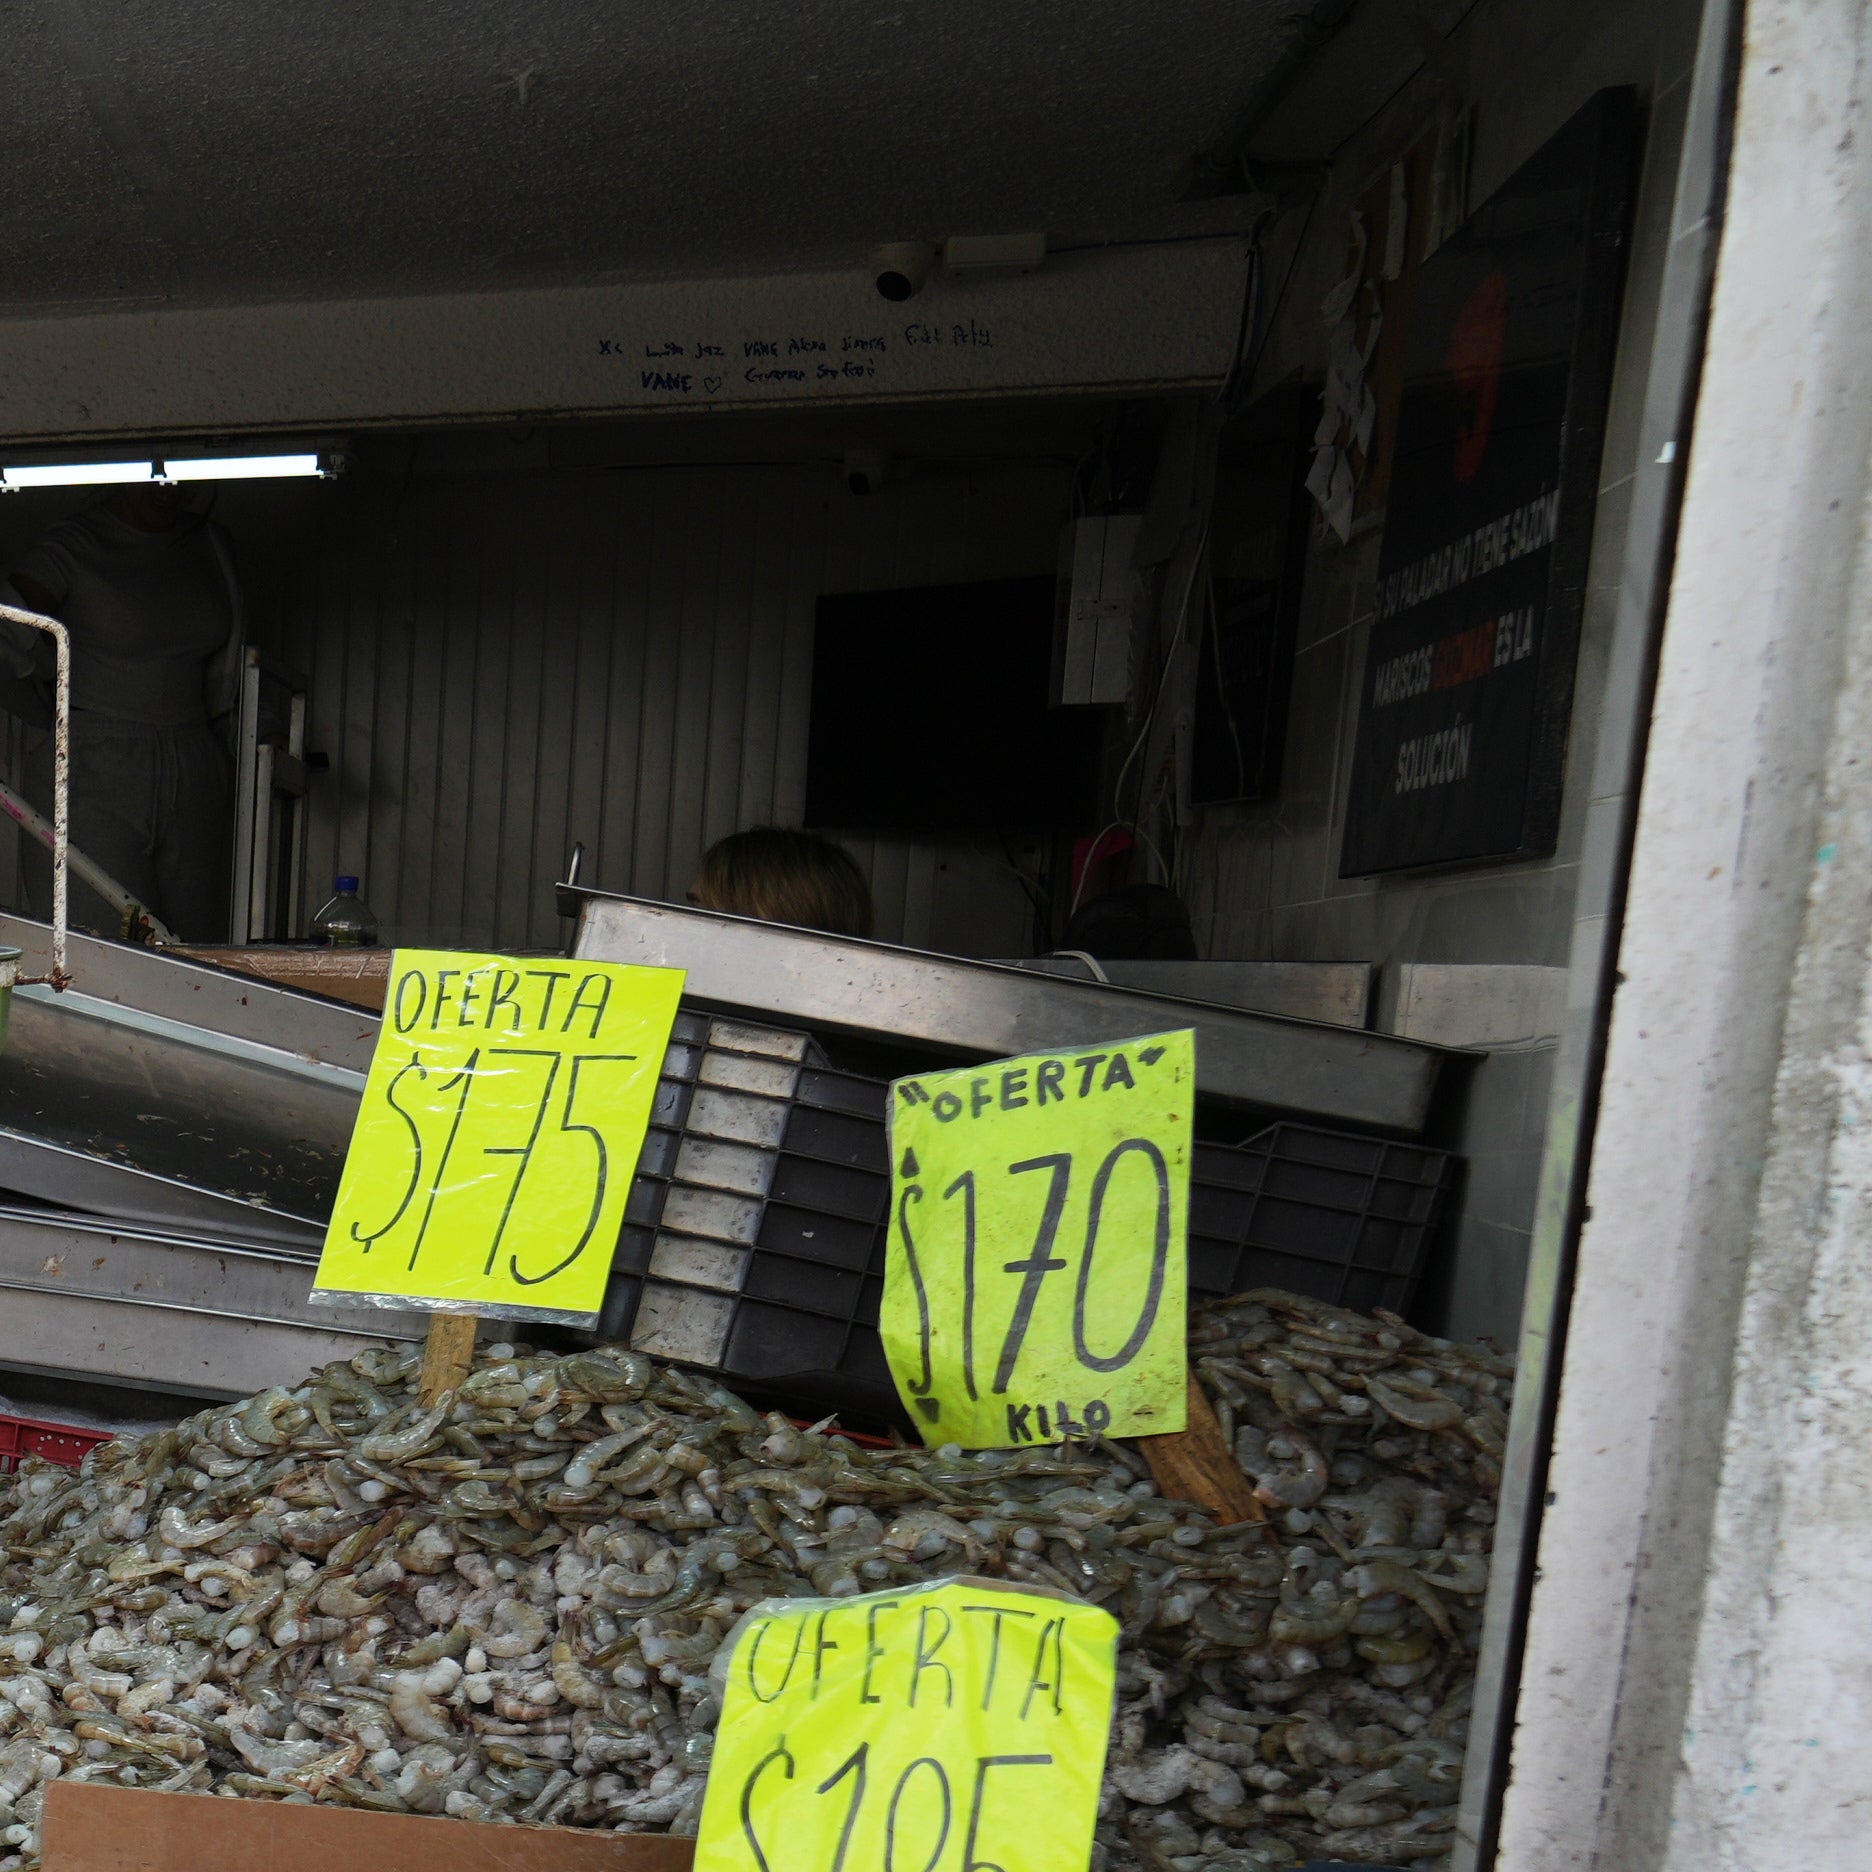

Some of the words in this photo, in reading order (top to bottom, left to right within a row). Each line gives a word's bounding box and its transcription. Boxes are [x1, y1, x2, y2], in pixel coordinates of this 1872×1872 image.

[1395, 711, 1473, 795] SOLUCIÓN
[394, 968, 613, 1040] OFERTA
[349, 1047, 638, 1287] $175
[898, 1137, 1171, 1425] $170
[1006, 1399, 1111, 1444] KILO
[747, 1600, 1067, 1721] OFERTA
